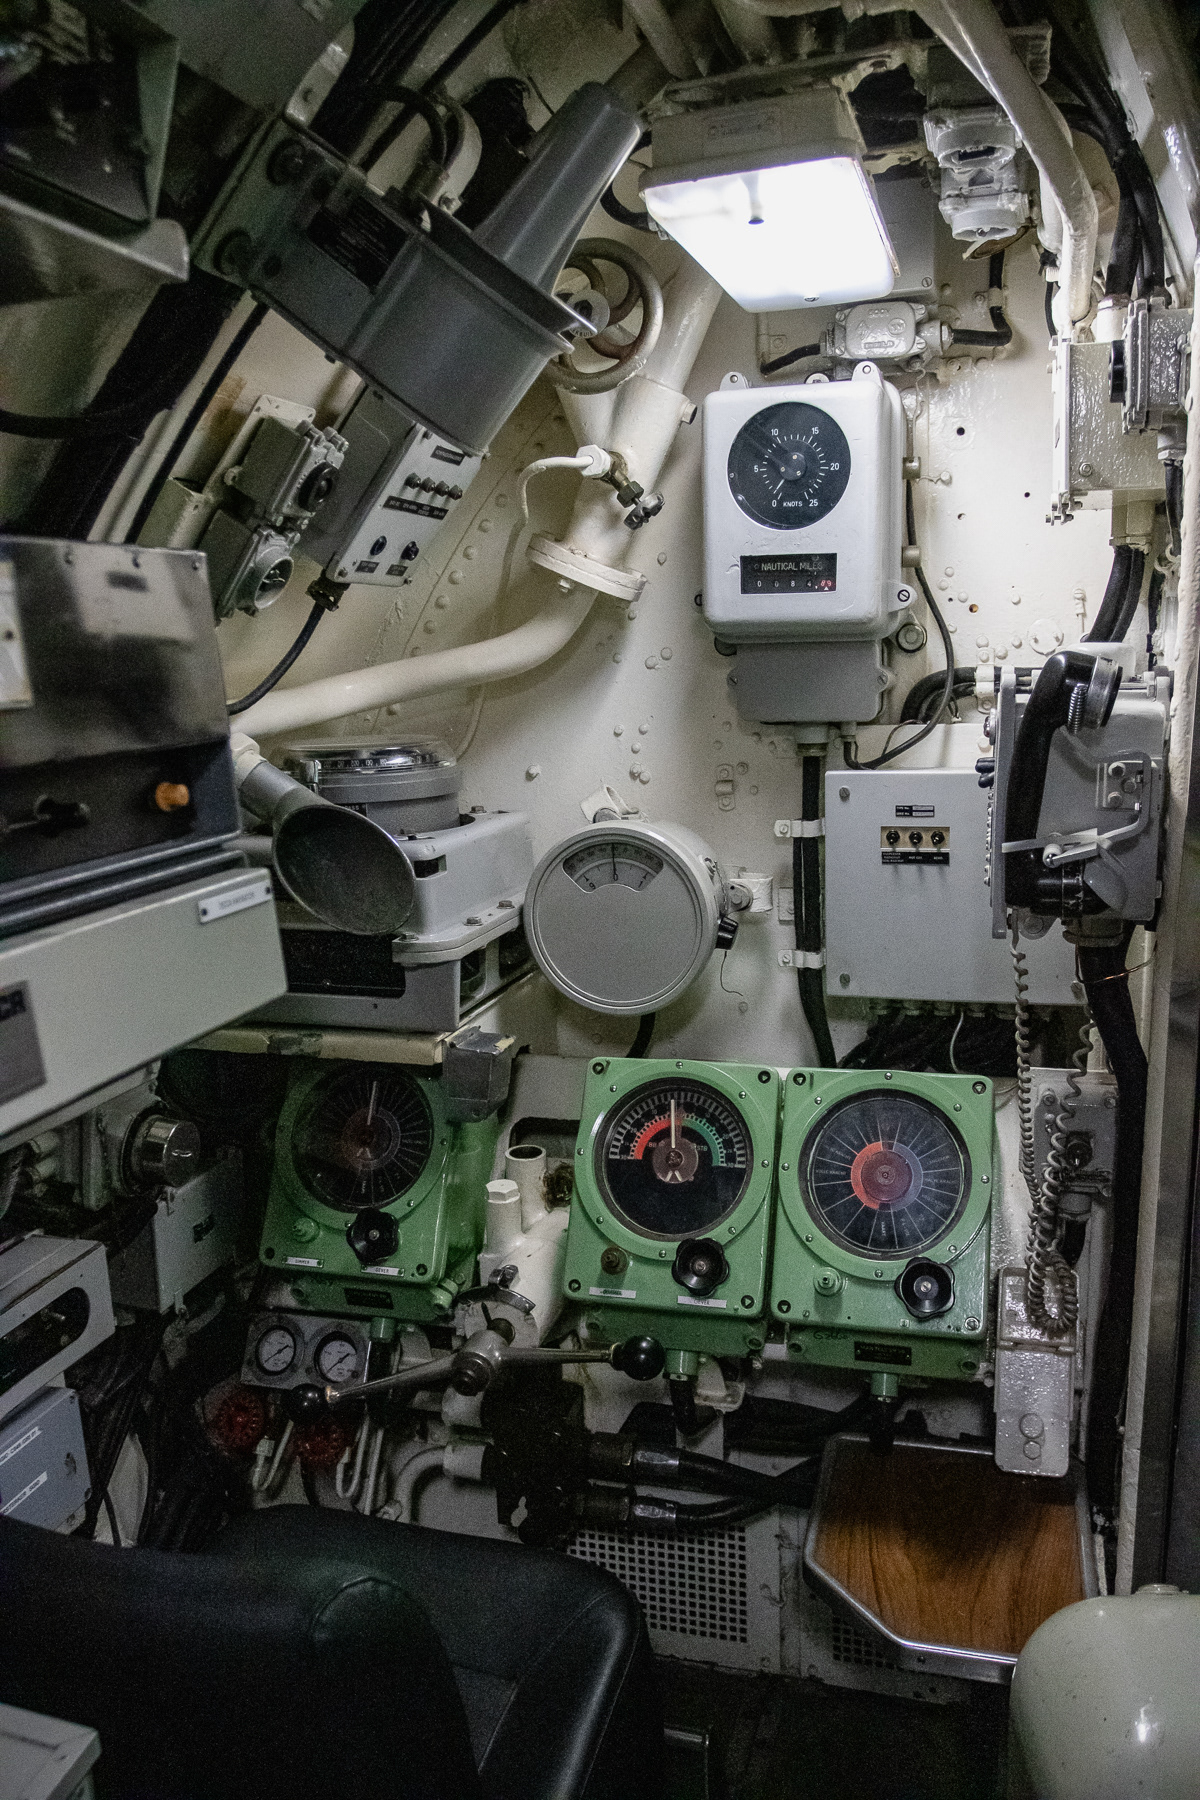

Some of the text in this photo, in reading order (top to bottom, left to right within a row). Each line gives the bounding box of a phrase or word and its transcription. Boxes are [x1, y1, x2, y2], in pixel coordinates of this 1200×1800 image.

[770, 428, 779, 436] 10
[811, 427, 820, 435] 15
[753, 465, 759, 473] 5
[829, 462, 840, 471] 20
[771, 499, 777, 508] 0
[808, 499, 819, 507] 25
[761, 561, 823, 571] NAUTICAL MILES
